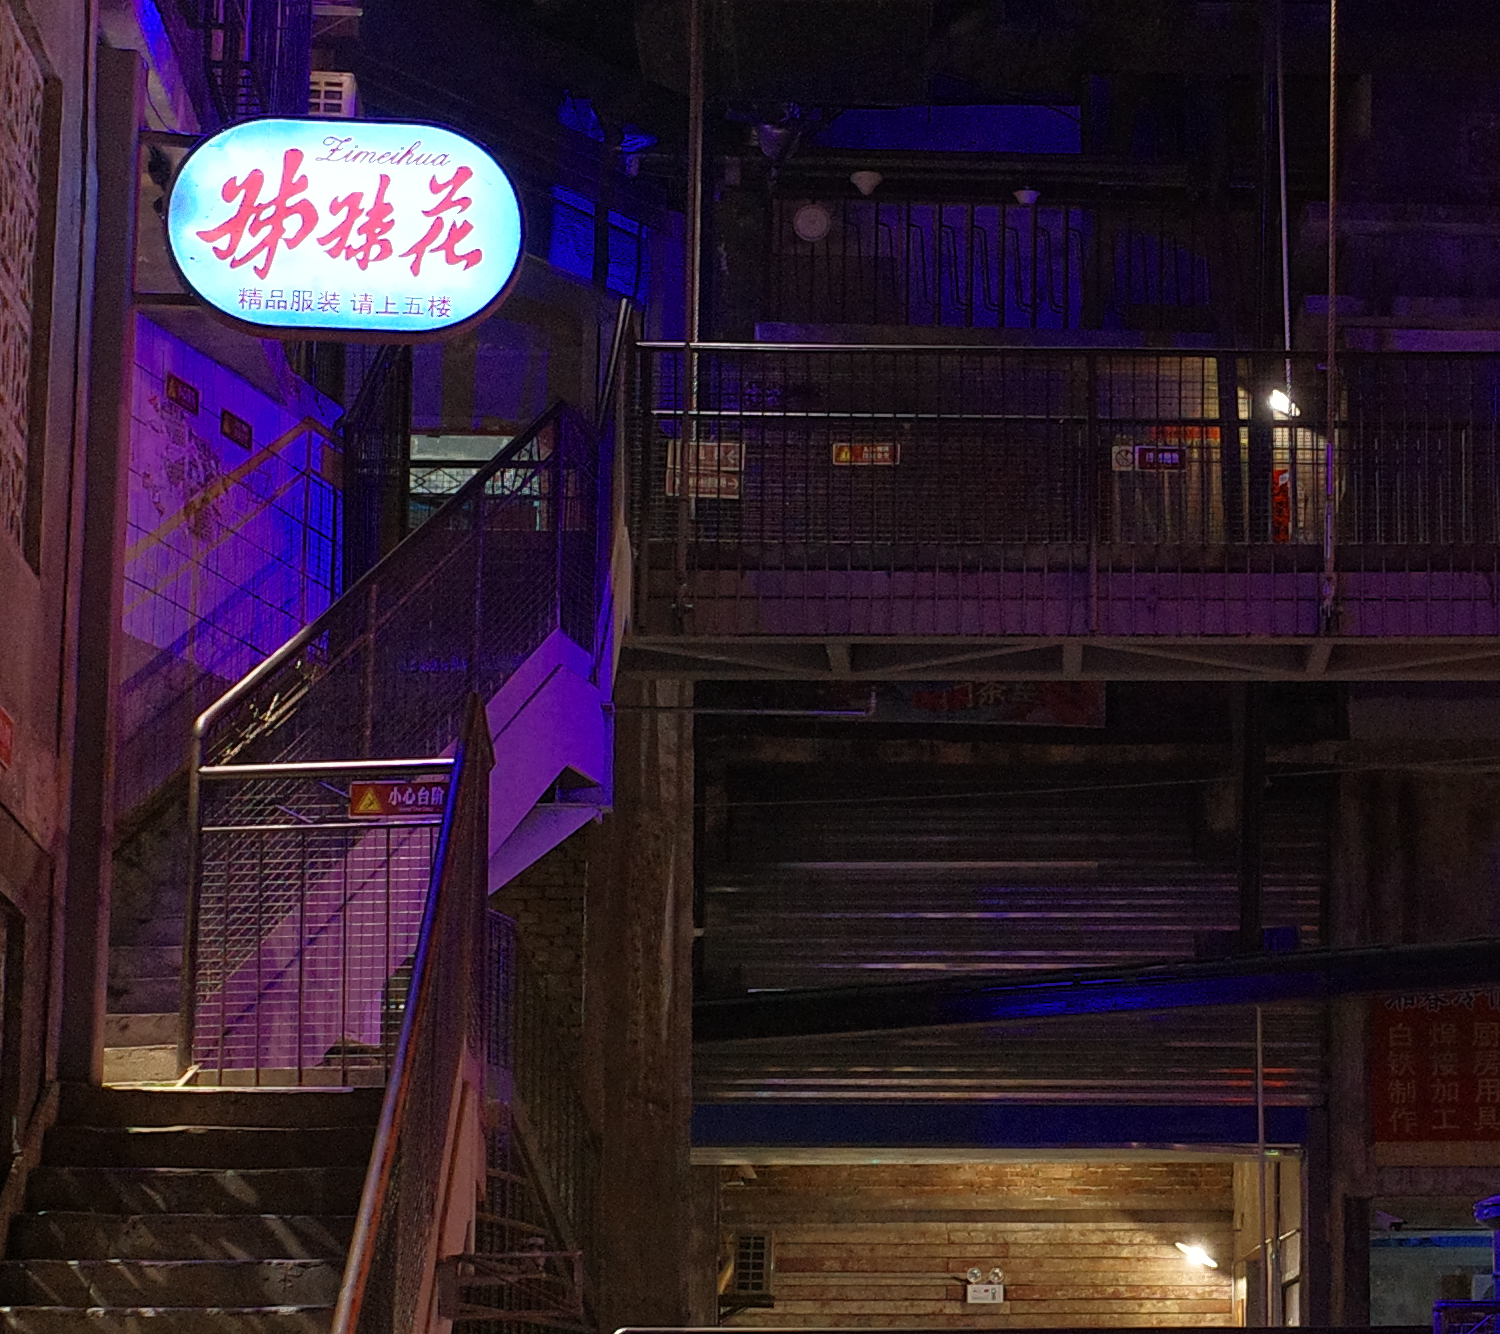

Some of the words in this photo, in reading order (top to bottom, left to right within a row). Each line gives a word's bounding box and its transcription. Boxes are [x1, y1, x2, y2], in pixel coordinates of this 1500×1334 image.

[314, 135, 451, 169] Zimeihua
[237, 286, 341, 315] 精品服装
[349, 291, 452, 319] 请上五楼
[1386, 1022, 1418, 1135] 白铁制作
